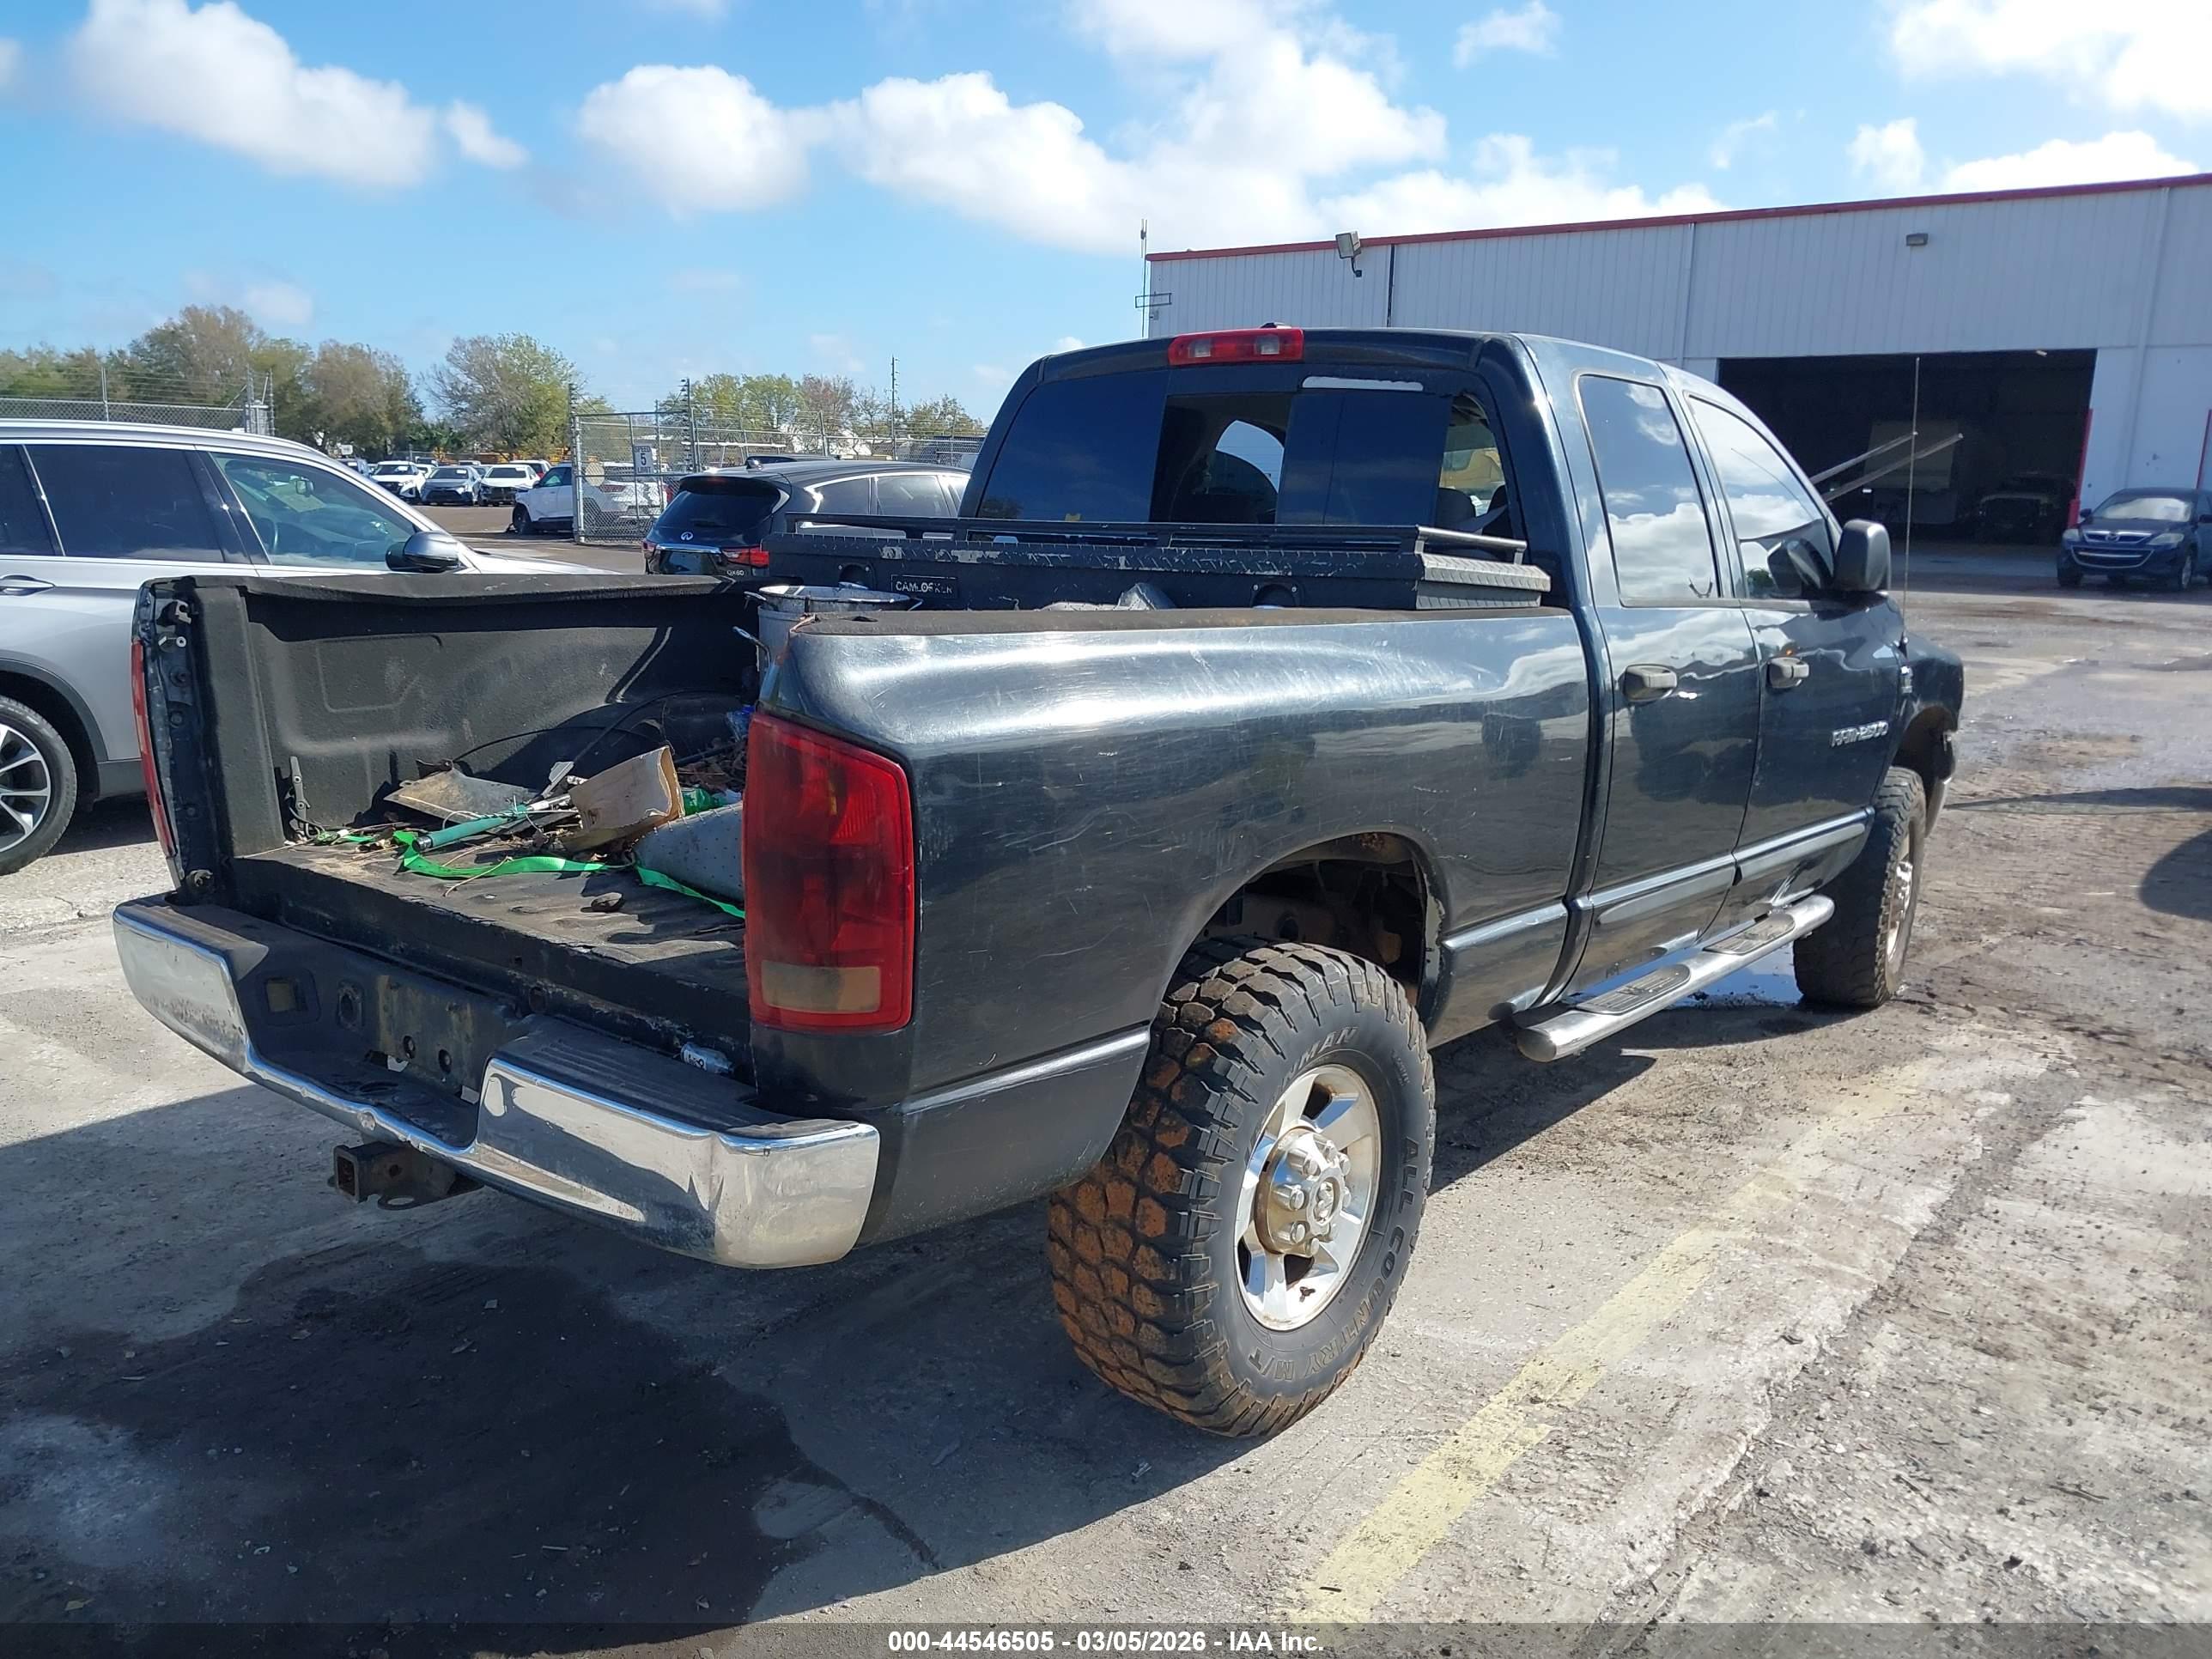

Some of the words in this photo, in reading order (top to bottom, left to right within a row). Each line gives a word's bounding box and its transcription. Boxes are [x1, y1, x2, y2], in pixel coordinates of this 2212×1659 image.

[641, 453, 647, 466] 5
[1397, 1136, 1419, 1214] ALL
[1304, 1224, 1406, 1376] COUNTRY
[1248, 1346, 1296, 1382] M/T
